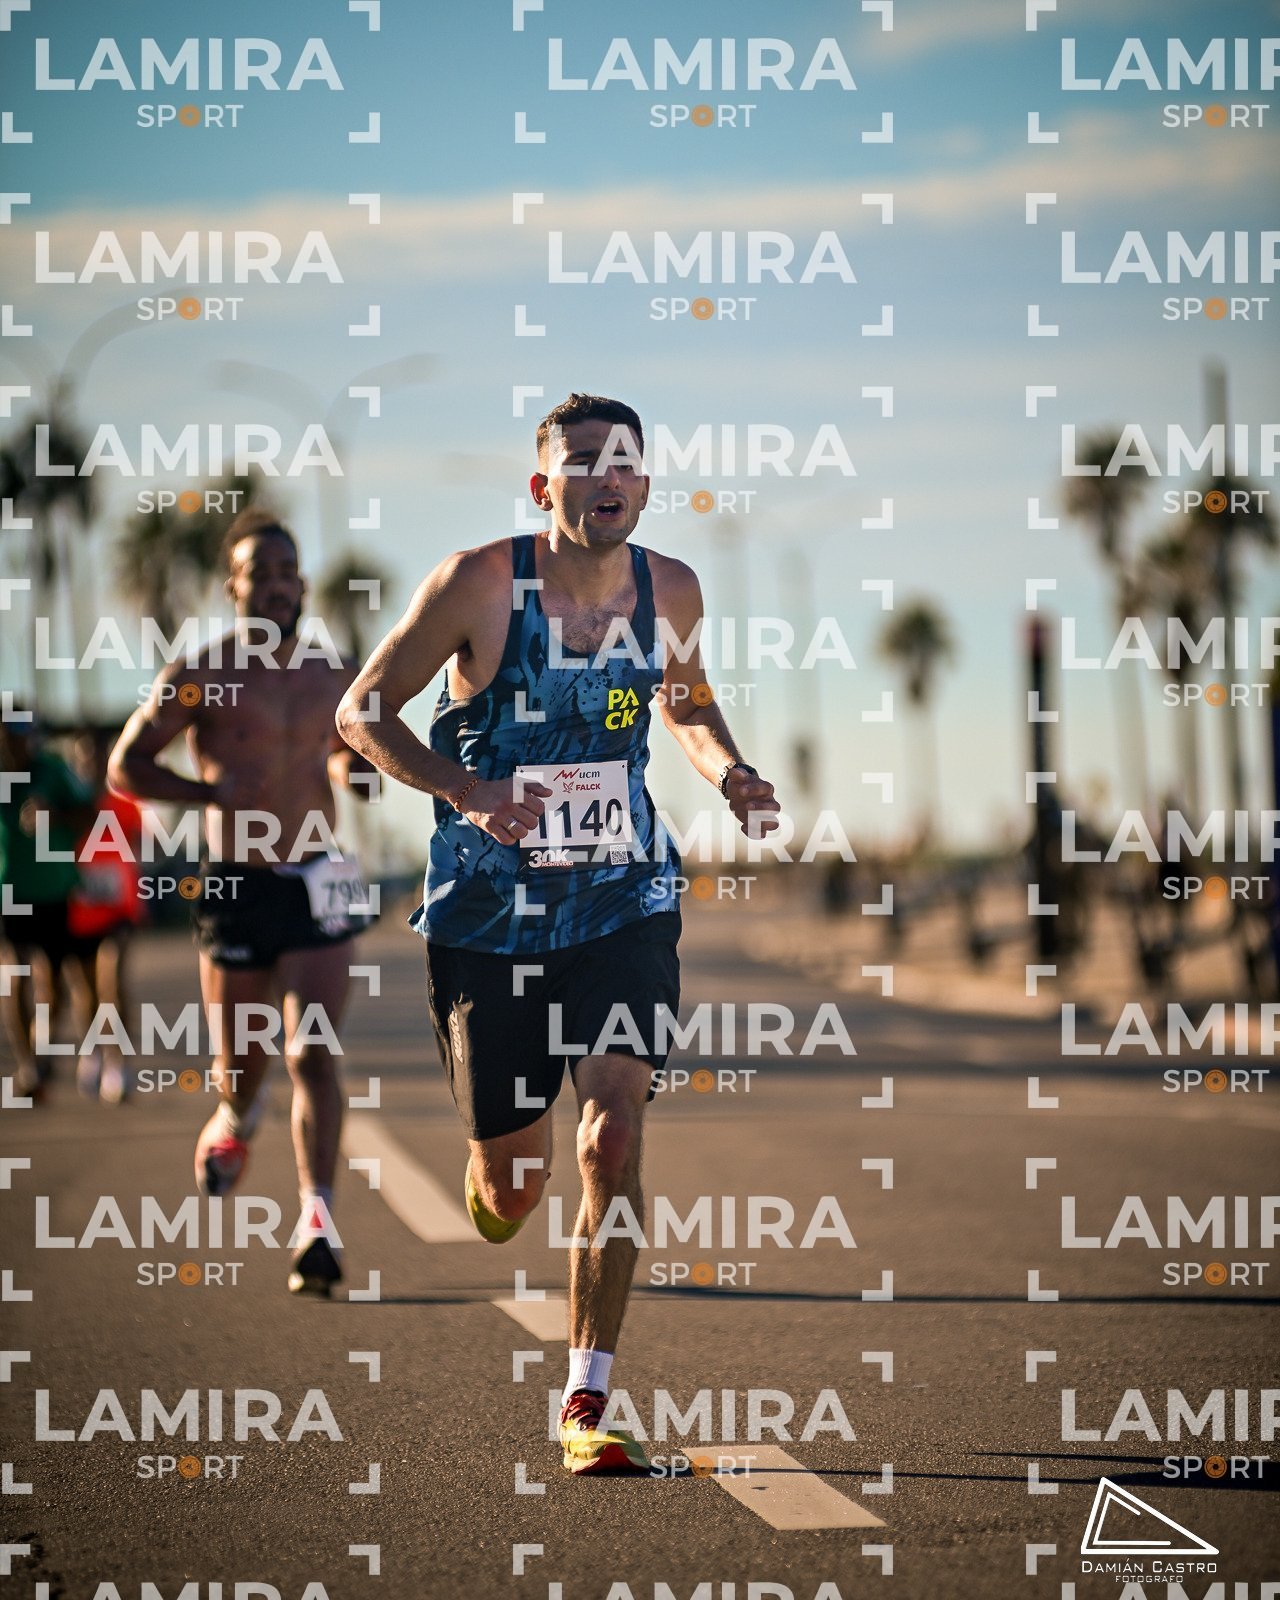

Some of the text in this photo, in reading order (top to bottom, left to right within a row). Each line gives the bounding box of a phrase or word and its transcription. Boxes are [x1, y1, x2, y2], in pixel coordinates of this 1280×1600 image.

[608, 687, 640, 710] PA
[605, 708, 639, 730] CK
[579, 770, 600, 779] ucm
[575, 783, 601, 791] FALCK
[528, 848, 570, 868] 30K
